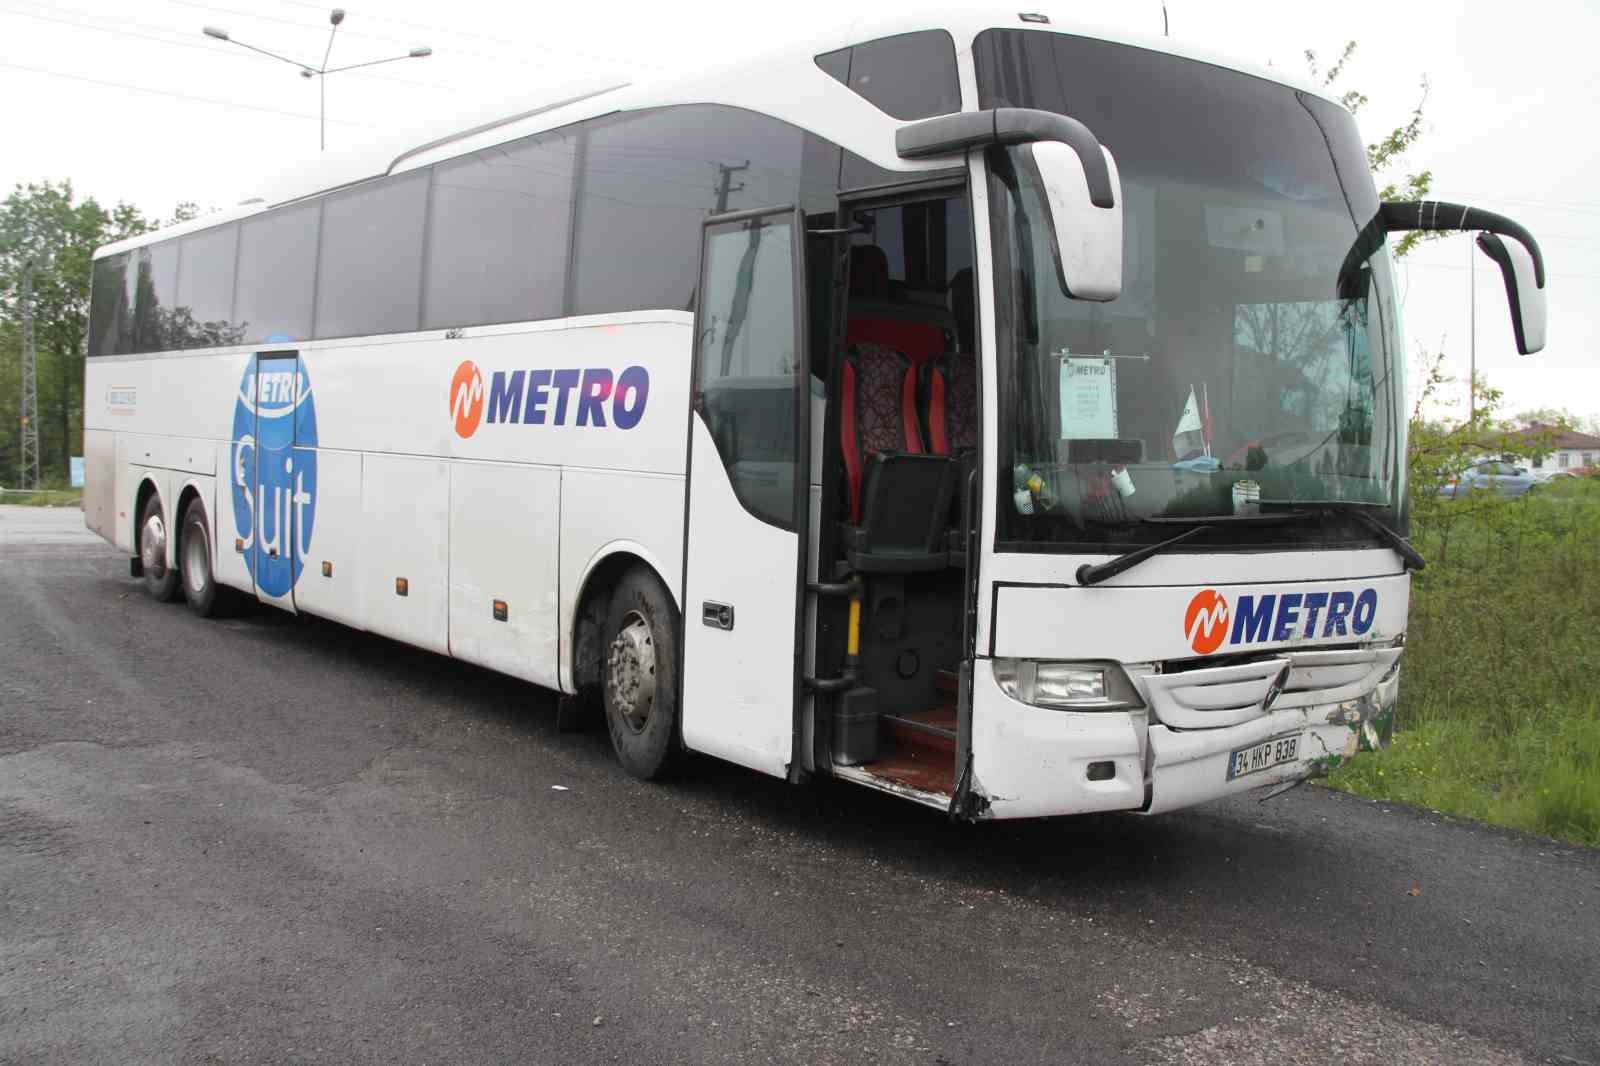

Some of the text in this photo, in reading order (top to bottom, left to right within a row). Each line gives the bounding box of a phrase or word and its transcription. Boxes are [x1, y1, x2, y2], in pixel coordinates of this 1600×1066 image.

[247, 371, 304, 403] METRO
[486, 365, 650, 430] METRO
[235, 434, 311, 567] Suit
[1230, 588, 1378, 645] METRO
[1236, 738, 1297, 774] 34 HKP 838
